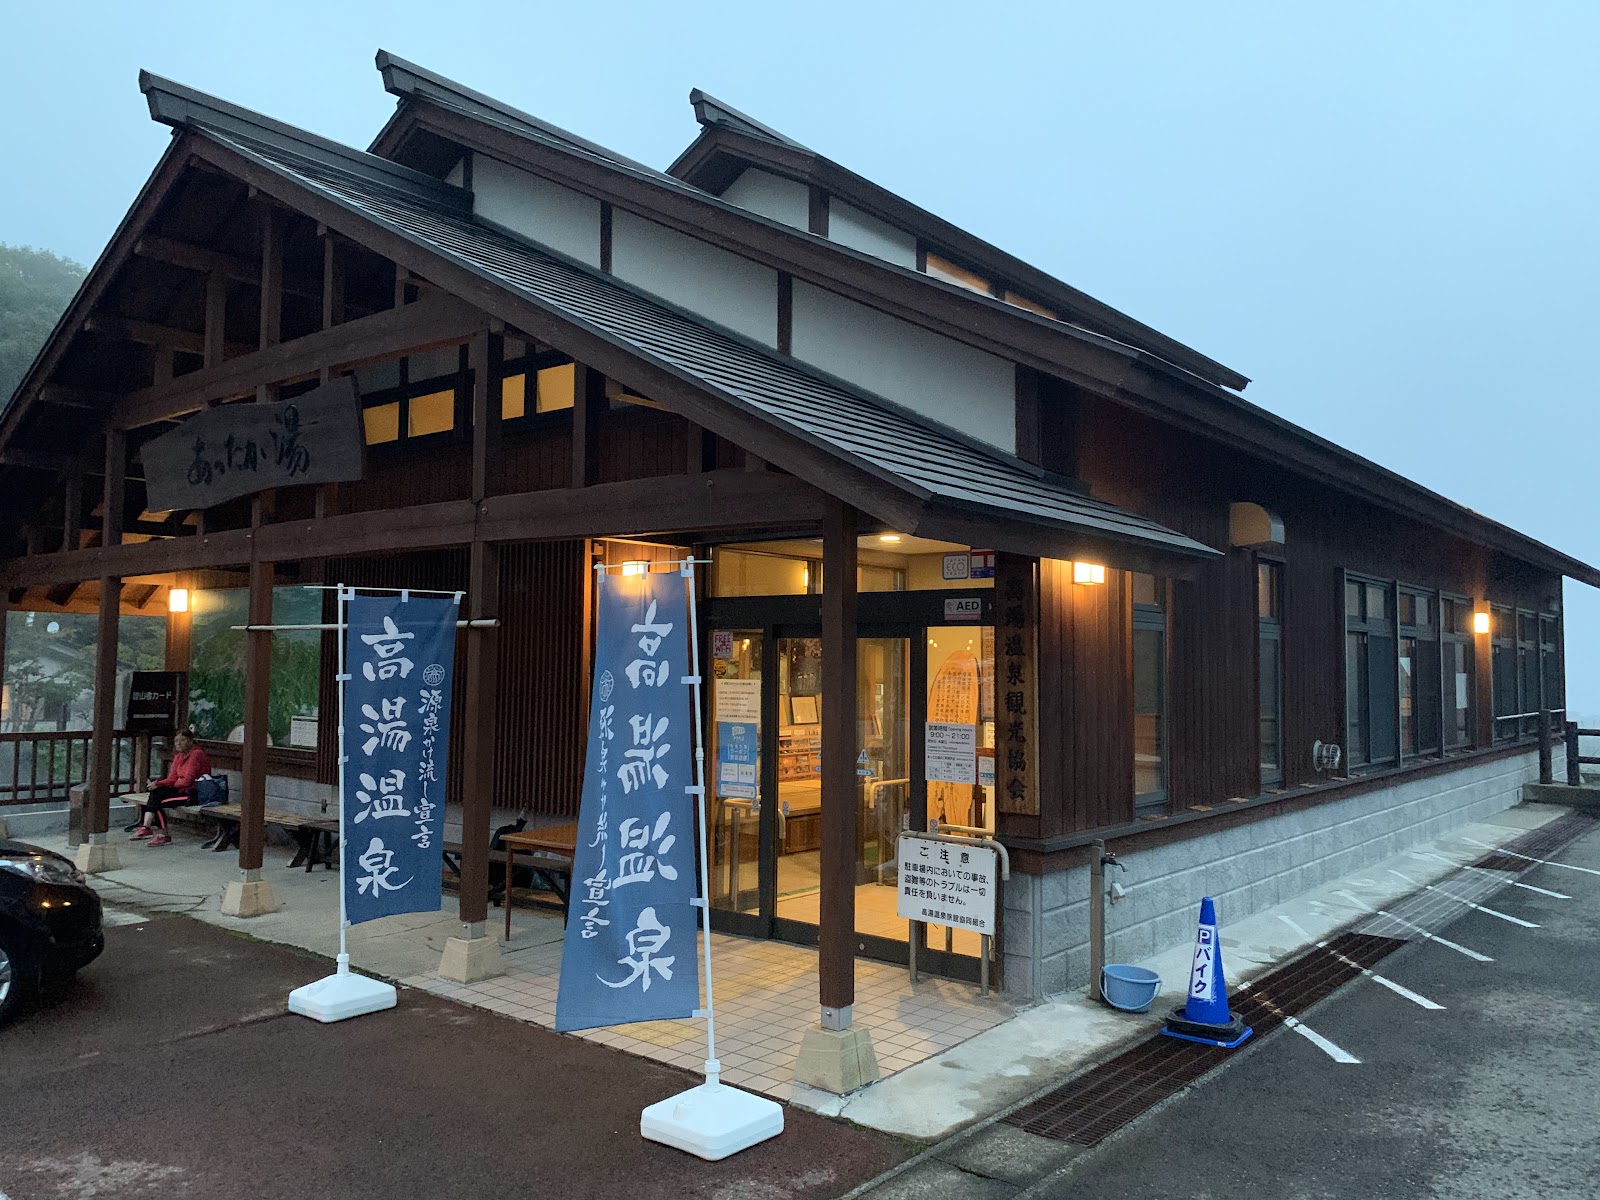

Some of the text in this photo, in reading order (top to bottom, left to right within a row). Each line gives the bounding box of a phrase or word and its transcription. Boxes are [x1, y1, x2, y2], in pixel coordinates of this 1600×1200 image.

[187, 404, 319, 485] あったか湯
[946, 562, 965, 572] ECO
[956, 601, 980, 611] AED
[714, 634, 731, 643] FREE
[353, 615, 415, 899] 高湯温泉
[411, 689, 444, 849] 源泉かけ流し宣言
[919, 846, 970, 864] ご注意
[904, 861, 989, 885] 駐車場内においての事故、
[904, 874, 987, 897] 盗難等のトラブルは一切
[904, 886, 967, 906] 責任を負いません。
[921, 908, 986, 928] 高湯温泉旅館協同組合
